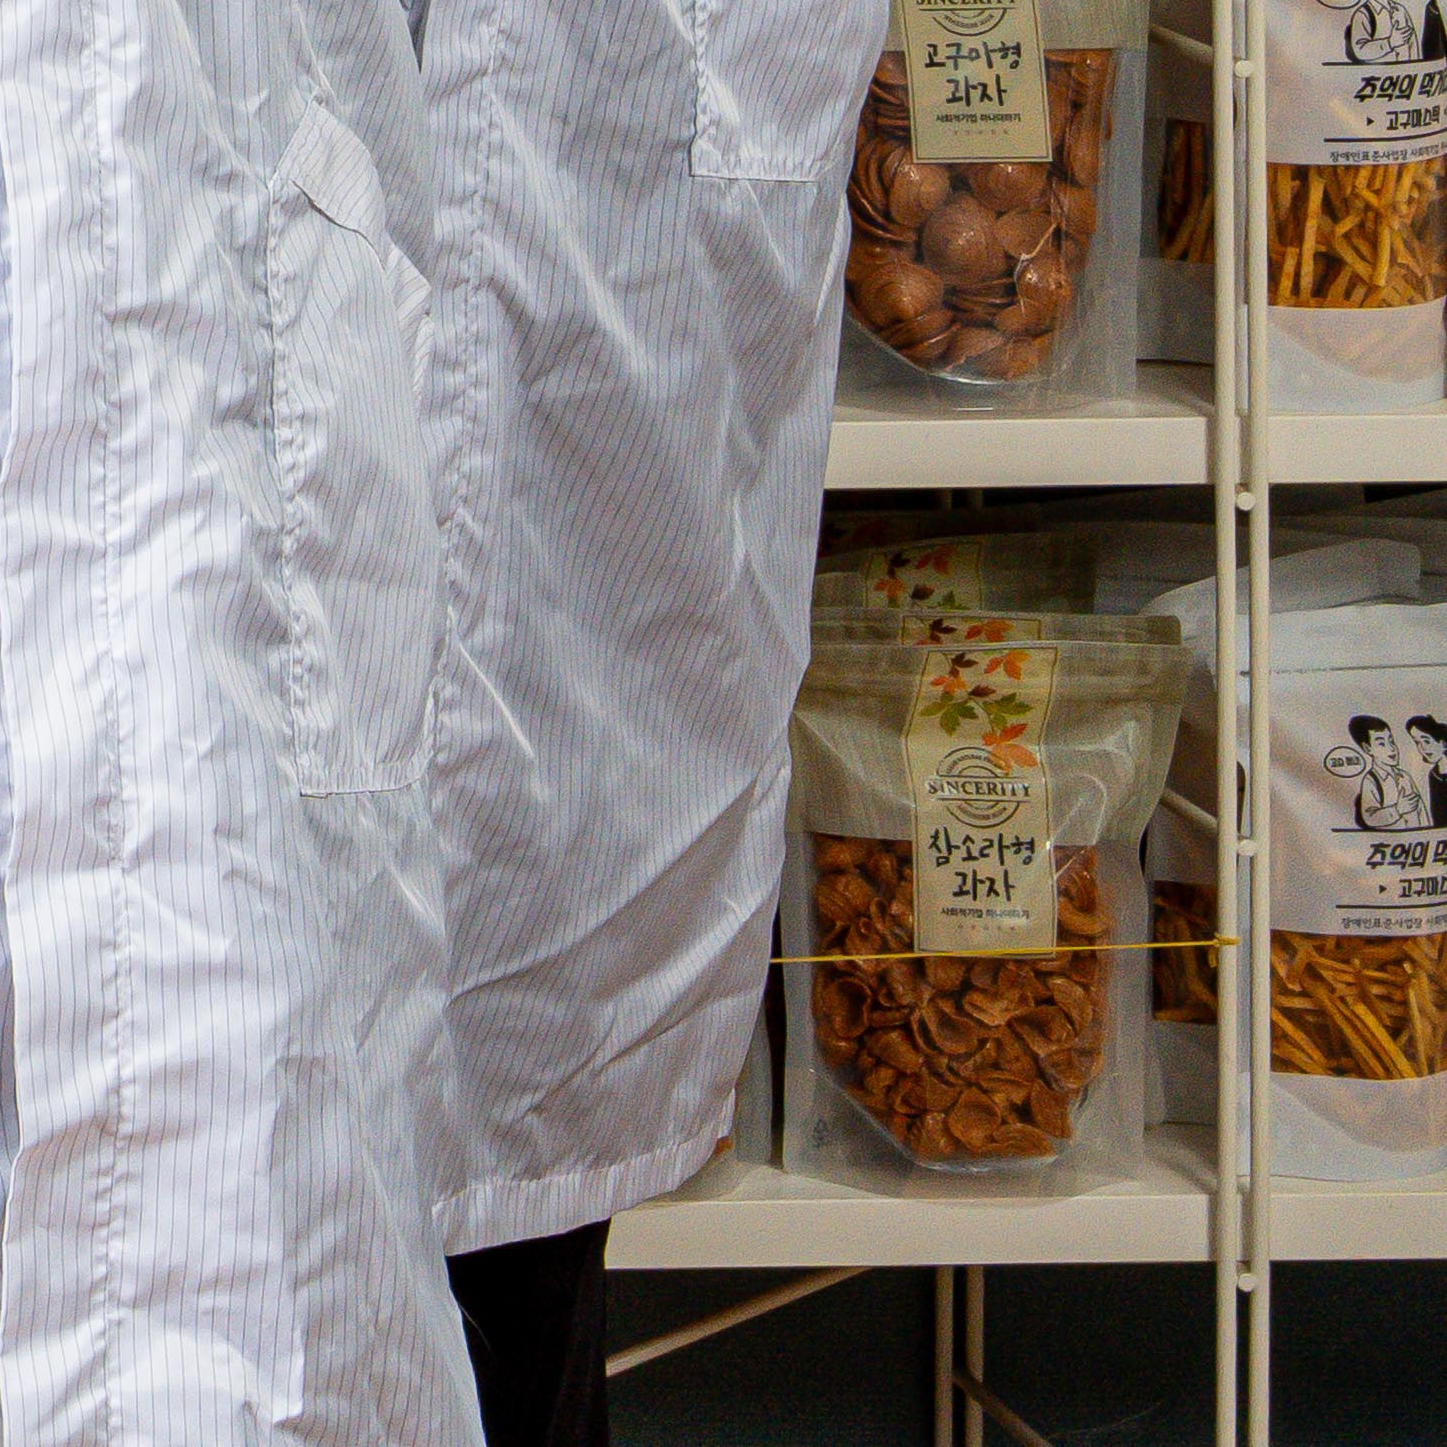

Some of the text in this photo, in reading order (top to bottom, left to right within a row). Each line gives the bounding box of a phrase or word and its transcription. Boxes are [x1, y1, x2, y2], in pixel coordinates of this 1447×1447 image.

[924, 40, 1022, 71] 고구마형
[946, 73, 1008, 107] 과자
[1354, 72, 1419, 103] 추억의
[1385, 104, 1440, 131] 고구마스틱
[1329, 149, 1408, 163] 장애인표준사업장
[927, 780, 1031, 797] SINCERITY
[928, 826, 1036, 867] 참소라형
[1365, 840, 1431, 870] 추억의
[952, 868, 1016, 902] 과자
